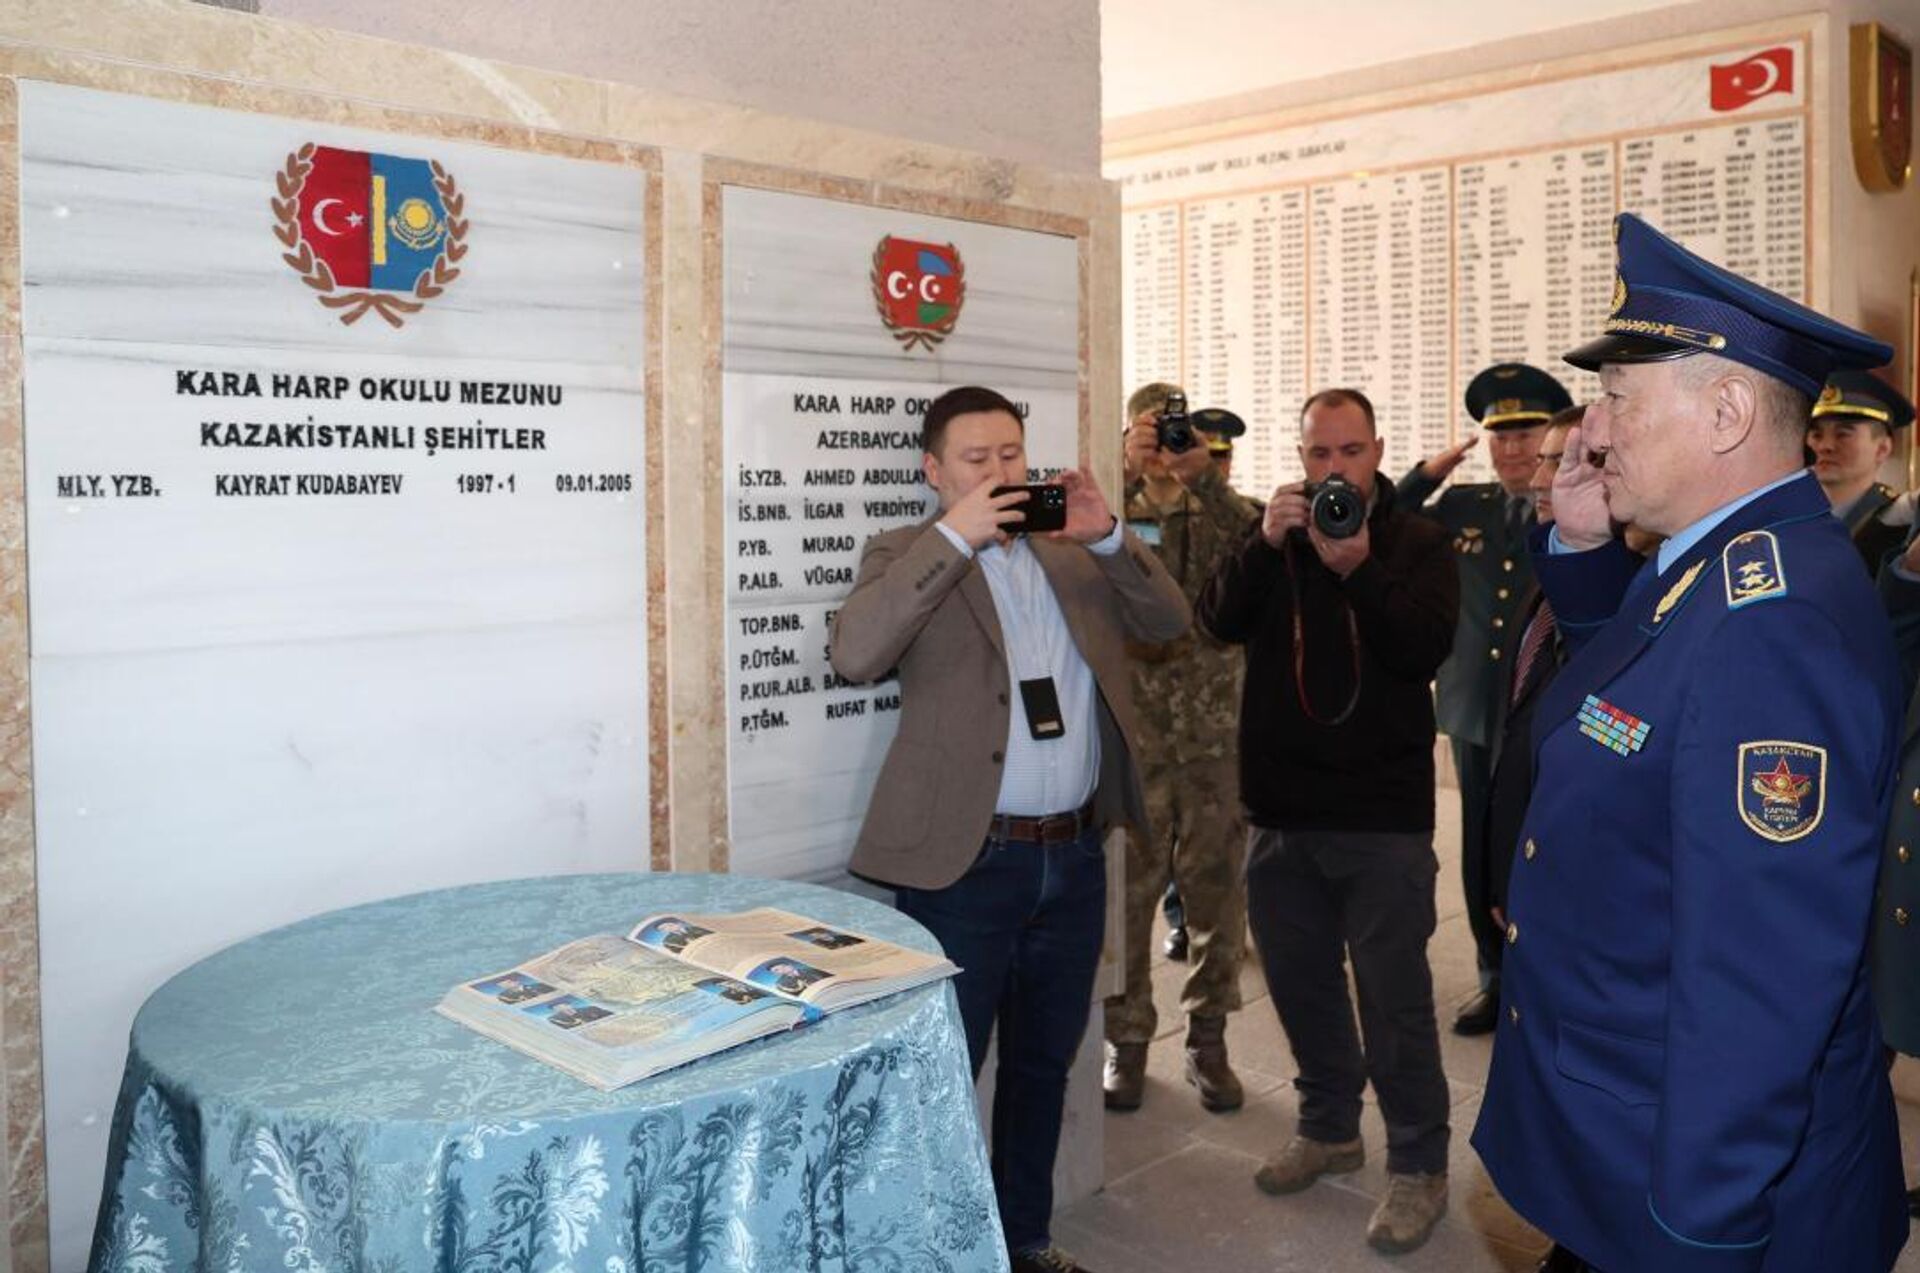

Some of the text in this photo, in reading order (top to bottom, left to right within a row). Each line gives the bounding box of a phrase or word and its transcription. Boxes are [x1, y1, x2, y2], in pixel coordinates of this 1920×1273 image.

[176, 369, 563, 407] KARA HARP OKULU MEZUNU
[793, 393, 841, 414] KARA
[850, 396, 896, 416] HARP
[200, 415, 546, 457] KAZAKİSTANLI ŞEHİTLER
[817, 430, 923, 449] AZERBAYCAN
[57, 474, 105, 498] MLY.
[111, 474, 161, 497] YZB.
[215, 474, 292, 497] KAYRAT
[296, 474, 403, 496] KUDABAYEV
[555, 473, 632, 493] 09.01.2005
[739, 463, 787, 488] İS.YZB.
[803, 468, 856, 486] AHMED
[863, 468, 926, 485] ABDULLAY
[738, 496, 926, 522] İS.BNB. İLGAR VERDİYEV
[738, 535, 856, 557] P.YB. MURAD
[738, 566, 853, 592] P.ALB. VÜGAR
[739, 613, 805, 636] TOP.BNB.
[740, 675, 817, 702] P.KUR.ALB.
[741, 707, 790, 732] P.TĞM.
[825, 695, 902, 720] RUFAT NAB
